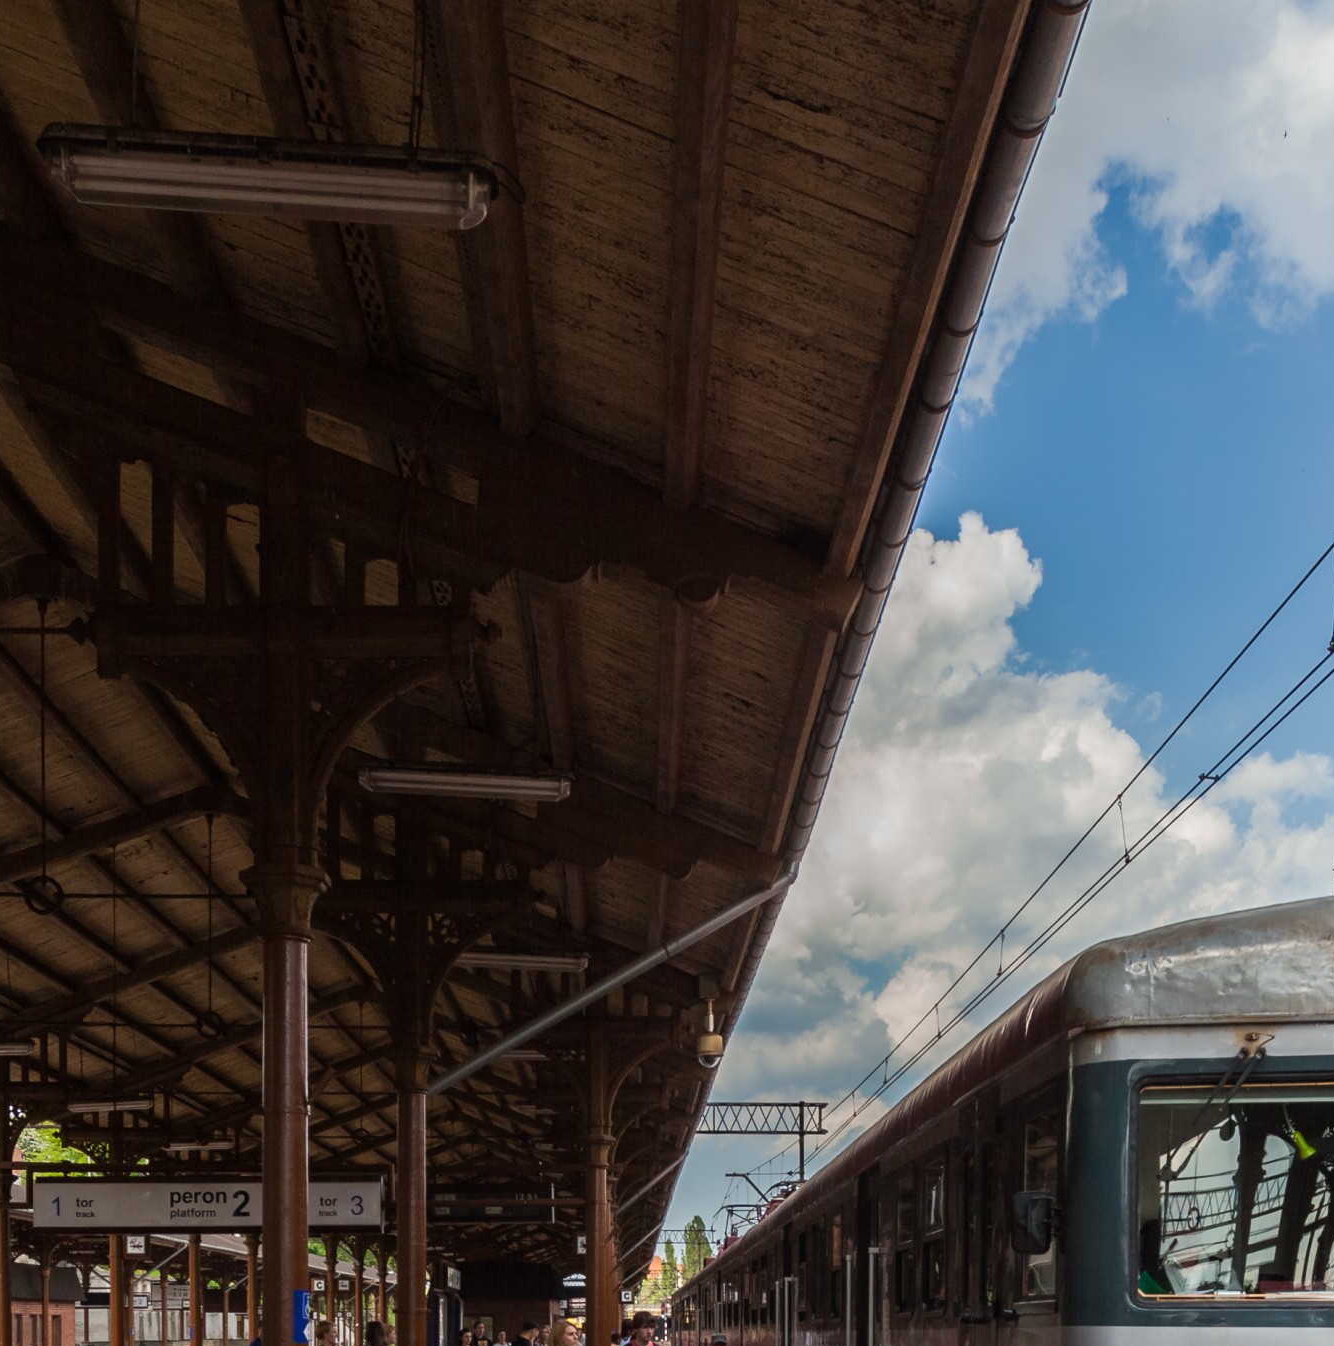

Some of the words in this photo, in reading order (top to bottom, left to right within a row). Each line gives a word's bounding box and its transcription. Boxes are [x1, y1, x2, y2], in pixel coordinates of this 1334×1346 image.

[51, 1196, 61, 1217] 1
[75, 1197, 94, 1207] tor
[170, 1190, 227, 1206] peron
[232, 1190, 251, 1217] 2
[319, 1196, 338, 1207] tor
[350, 1195, 365, 1216] 3
[170, 1207, 217, 1219] platform
[316, 1281, 323, 1290] C
[623, 1292, 630, 1300] C
